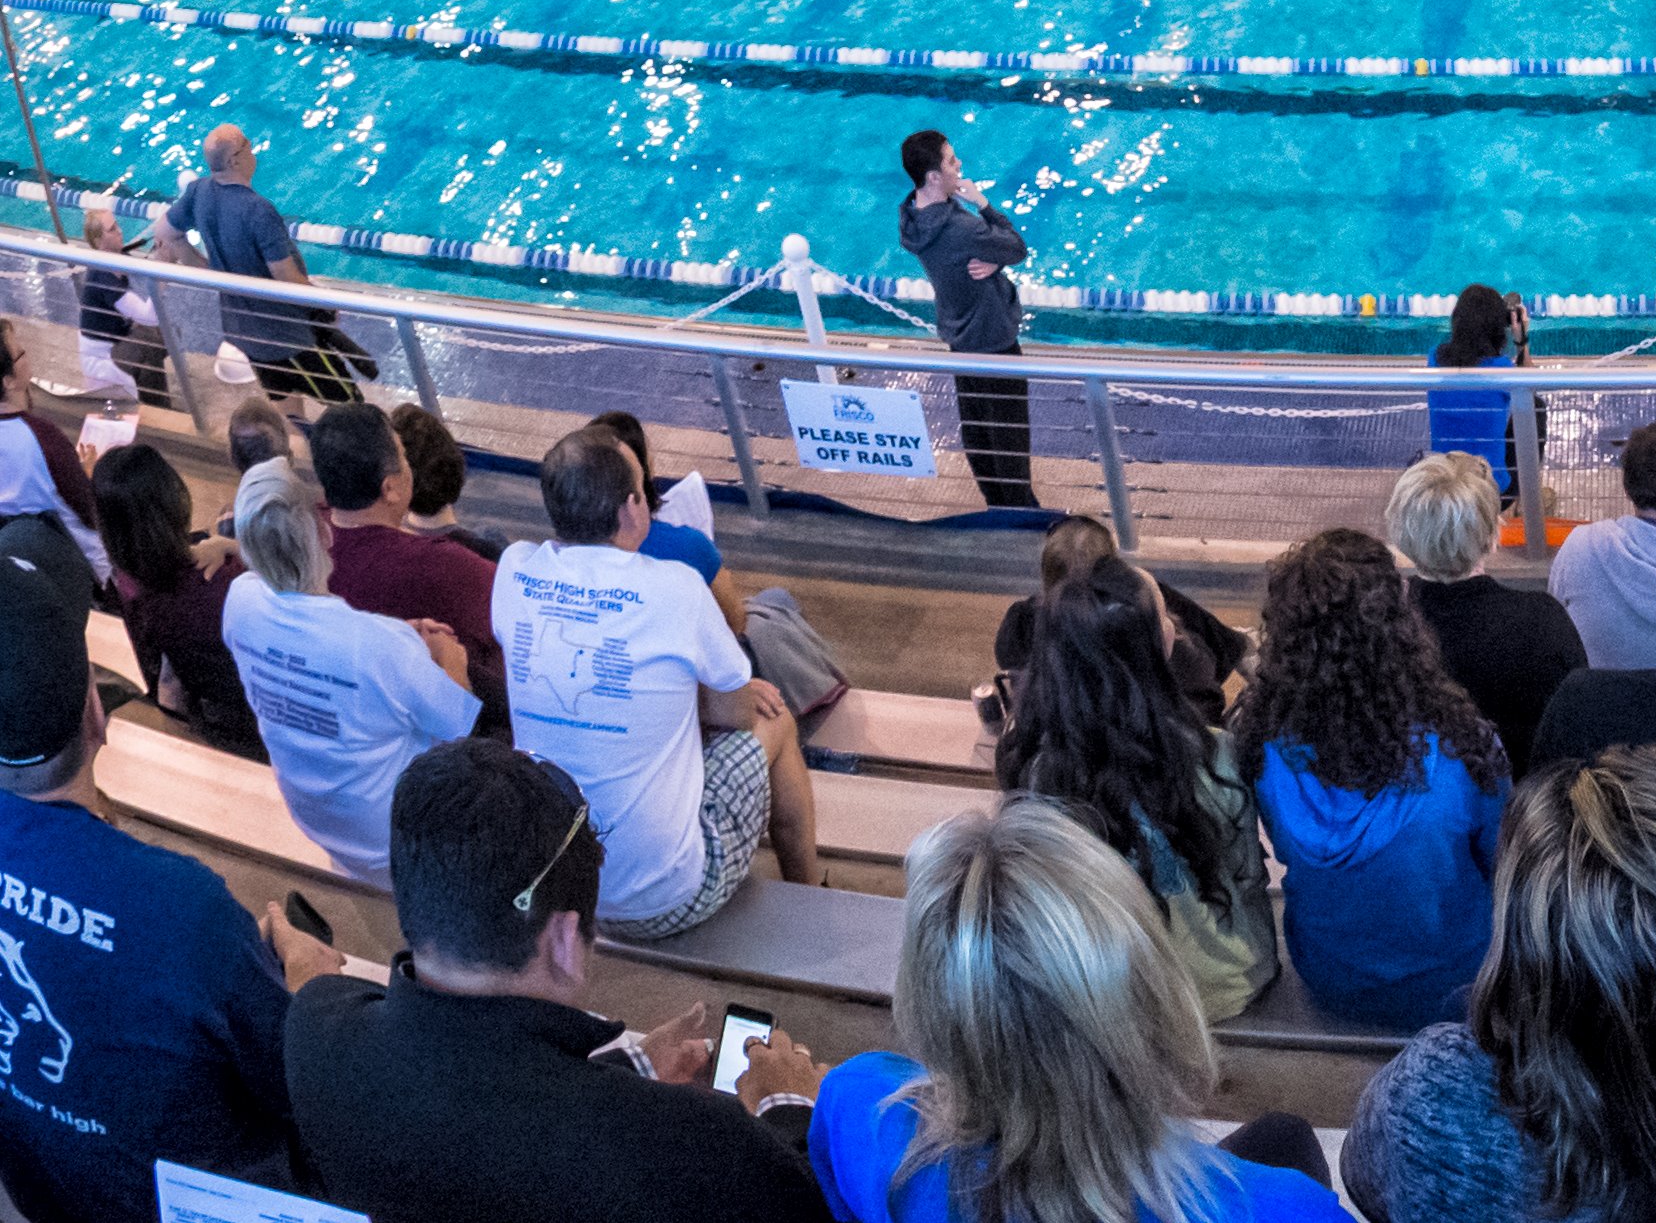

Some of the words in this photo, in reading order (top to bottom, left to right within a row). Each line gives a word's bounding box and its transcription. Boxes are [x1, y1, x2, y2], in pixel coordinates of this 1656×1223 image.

[834, 408, 875, 423] FRISCO
[798, 426, 871, 446] PLEASE
[875, 432, 922, 450] STAY
[816, 447, 850, 463] OFF
[857, 450, 913, 468] RAILS
[523, 587, 556, 602] STATE
[554, 581, 586, 599] HIGH
[588, 588, 645, 605] SCHOOL
[10, 1083, 45, 1113] bar
[51, 1105, 107, 1136] high
